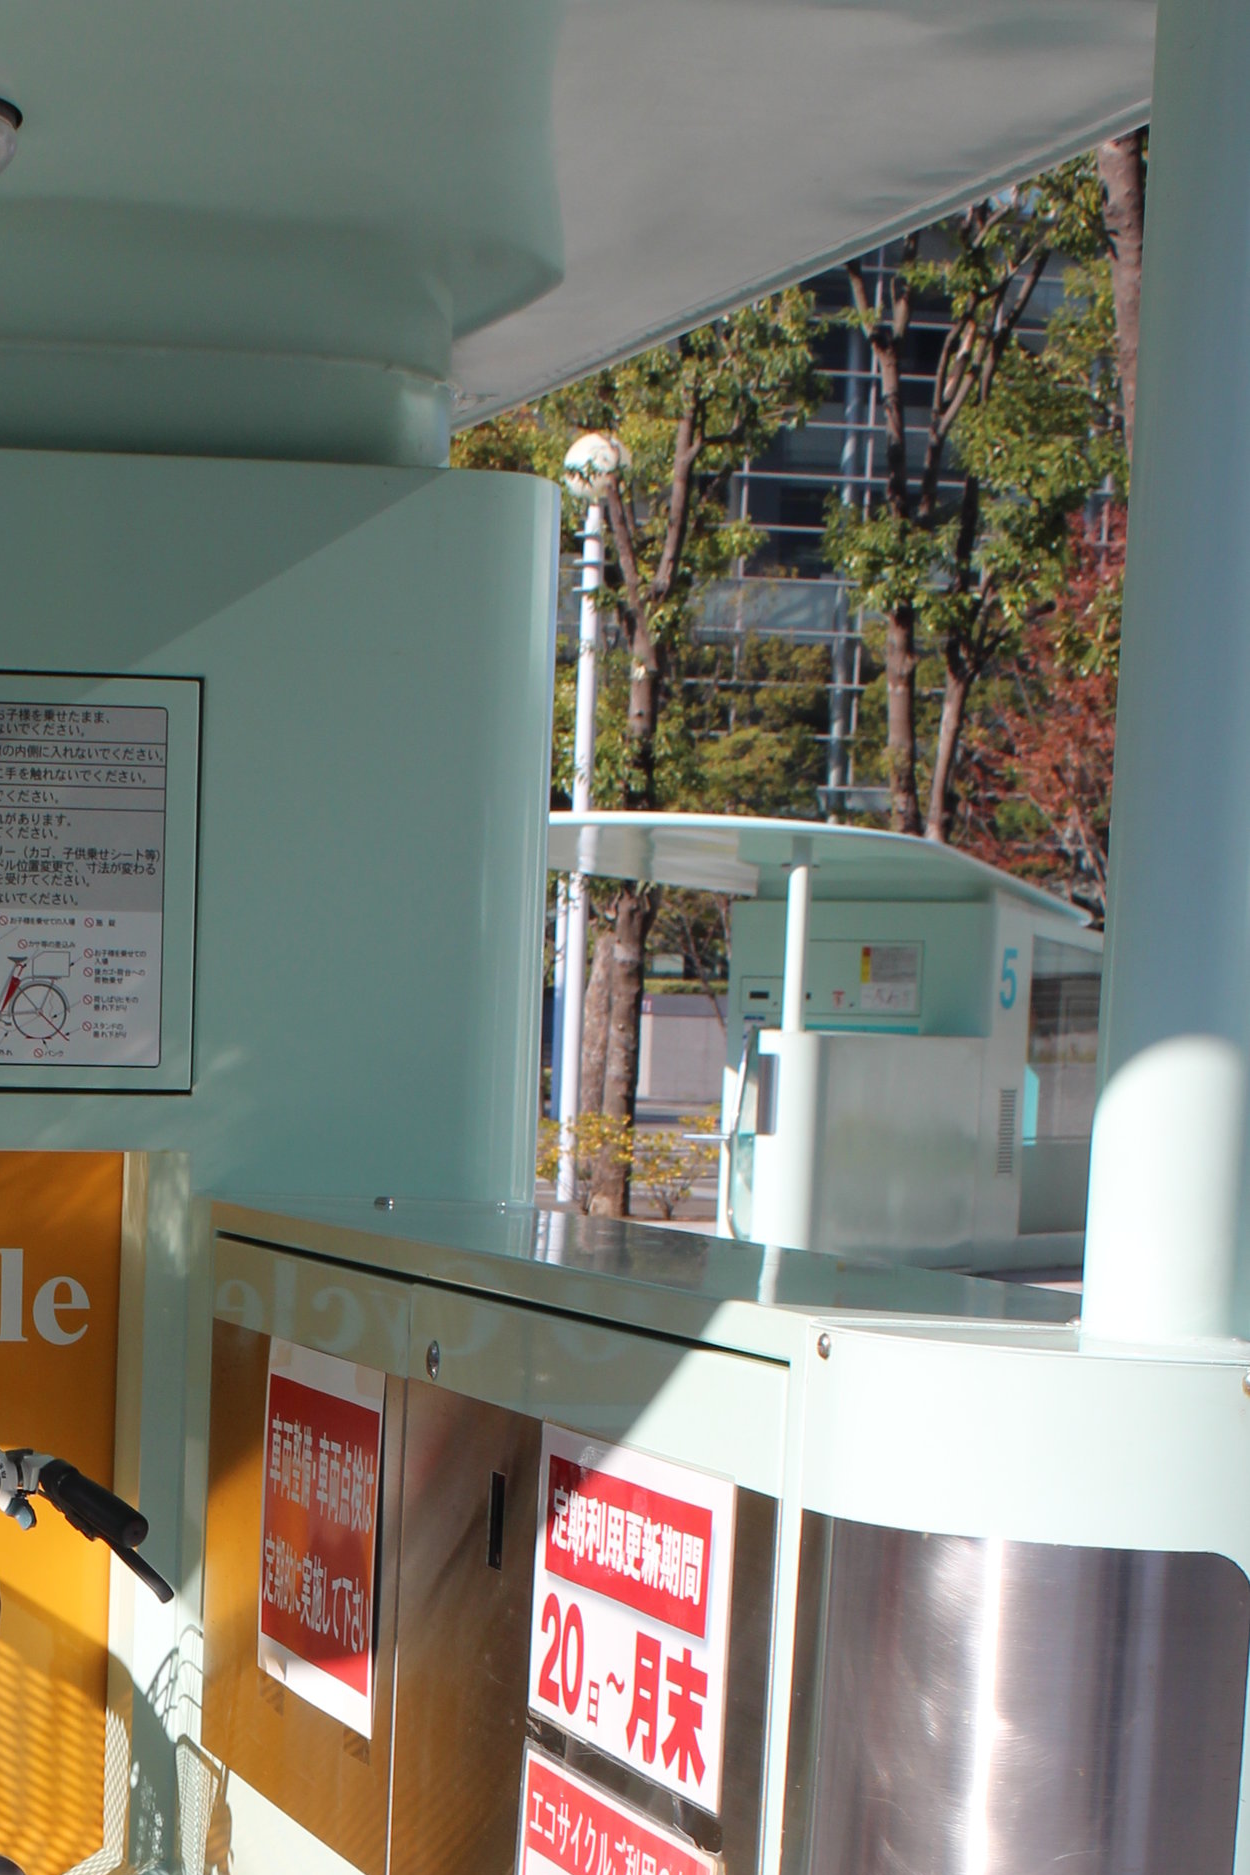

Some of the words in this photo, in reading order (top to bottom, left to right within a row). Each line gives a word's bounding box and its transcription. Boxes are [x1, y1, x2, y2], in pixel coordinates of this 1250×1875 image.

[999, 948, 1018, 1009] 5
[550, 1487, 706, 1607] 定期利用更新期間
